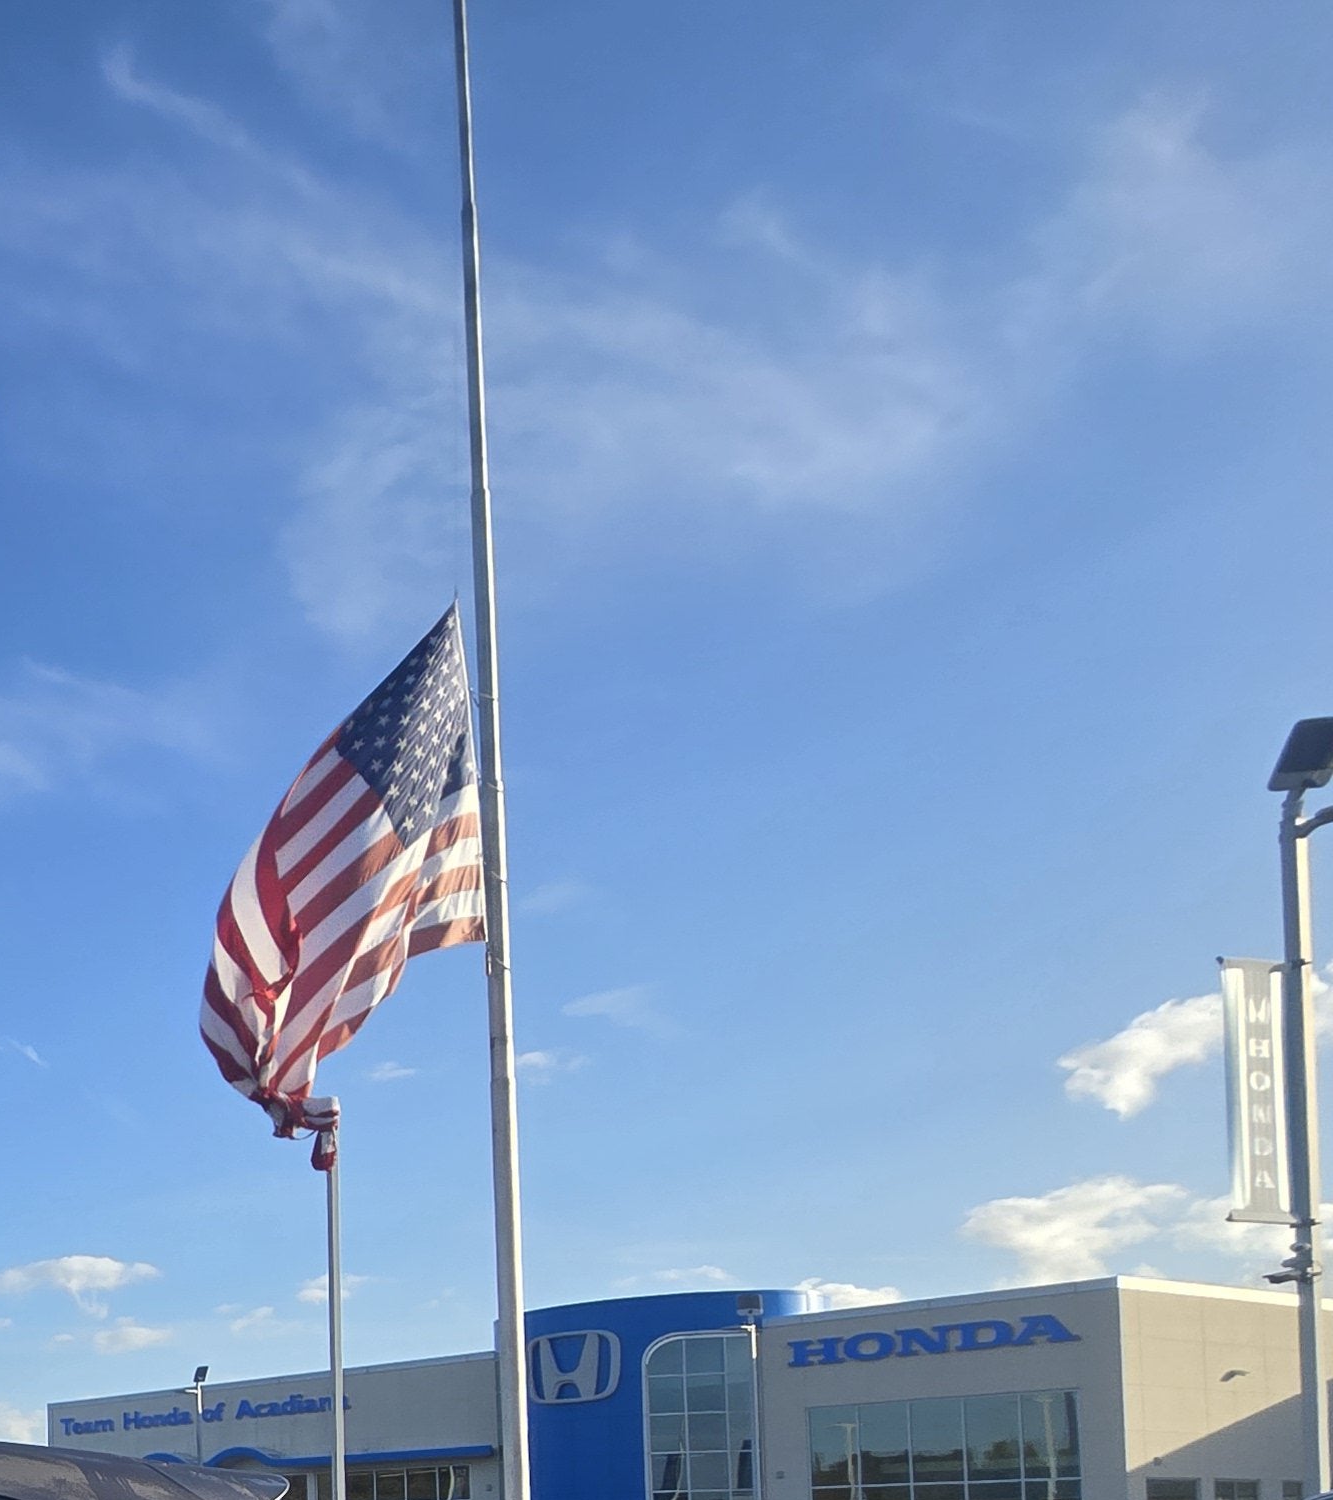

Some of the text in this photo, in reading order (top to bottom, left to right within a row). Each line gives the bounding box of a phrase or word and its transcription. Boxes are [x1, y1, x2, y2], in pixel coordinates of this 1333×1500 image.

[1247, 1037, 1277, 1190] HONDA
[787, 1314, 1081, 1367] HONDA
[60, 1417, 115, 1436] Team
[123, 1407, 194, 1432] Honda
[202, 1402, 226, 1424] of
